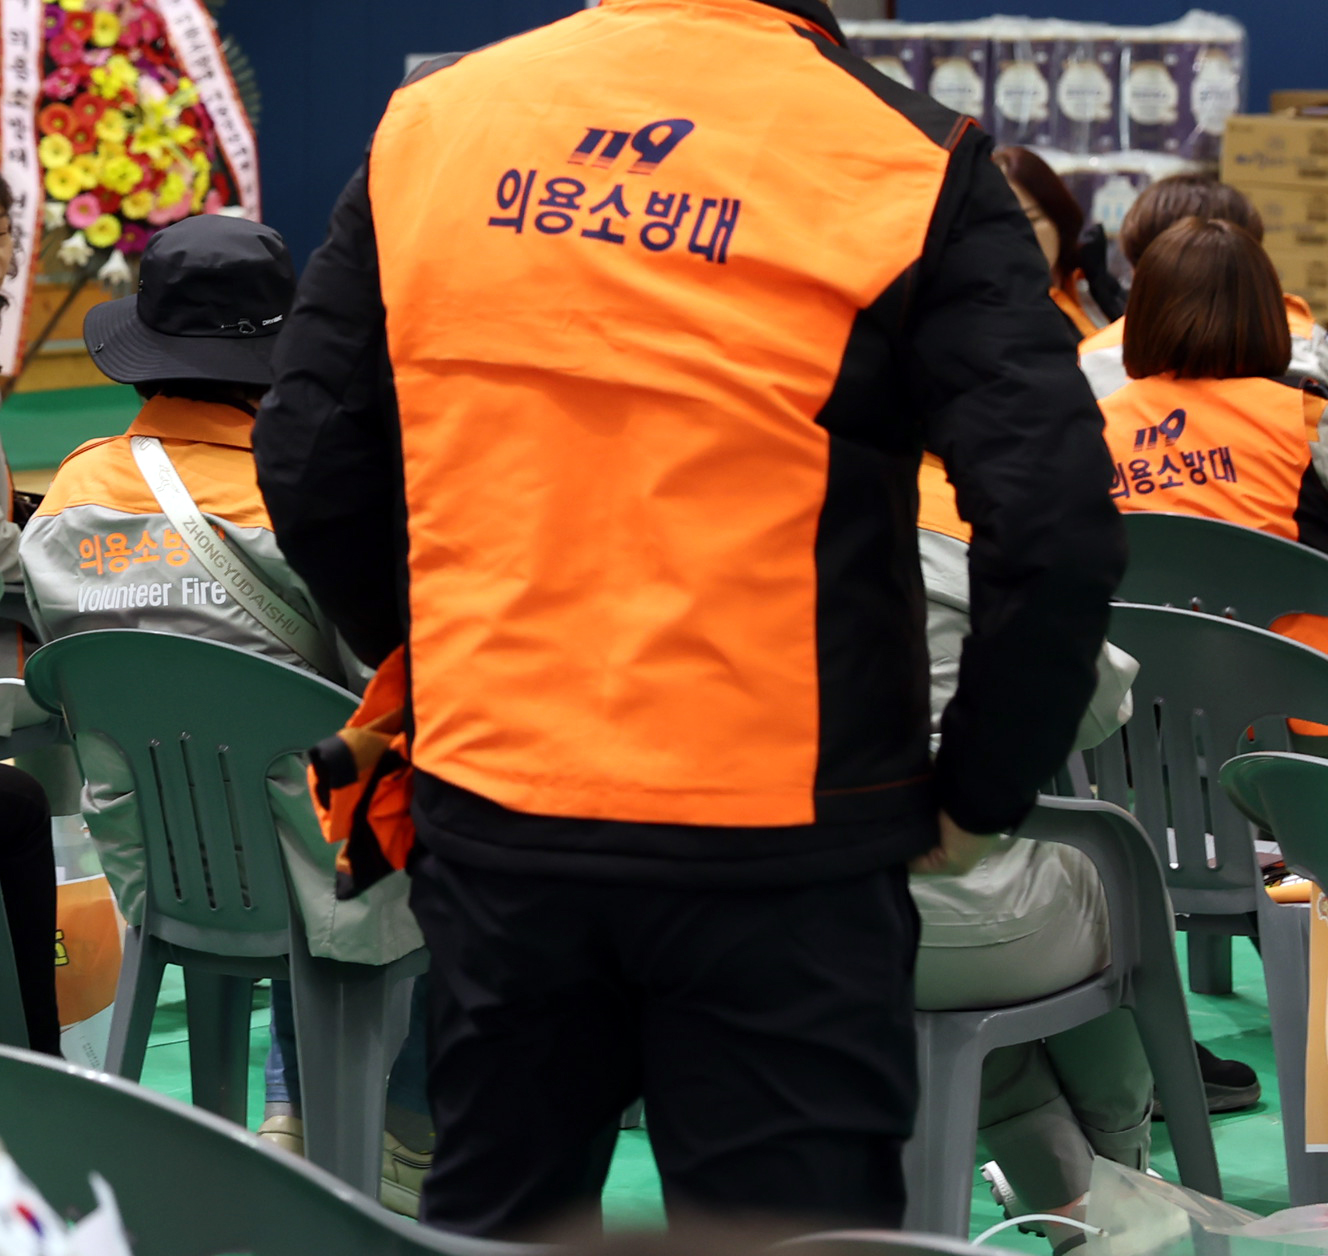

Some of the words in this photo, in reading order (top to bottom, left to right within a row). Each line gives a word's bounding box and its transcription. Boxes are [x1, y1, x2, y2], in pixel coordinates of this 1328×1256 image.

[567, 118, 695, 175] 119
[488, 168, 741, 264] 의용소방대
[1133, 418, 1187, 453] 119
[1108, 446, 1237, 500] 의용소방대
[79, 528, 225, 576] 의용소방
[77, 581, 173, 613] Volunteer
[181, 577, 227, 605] Fire
